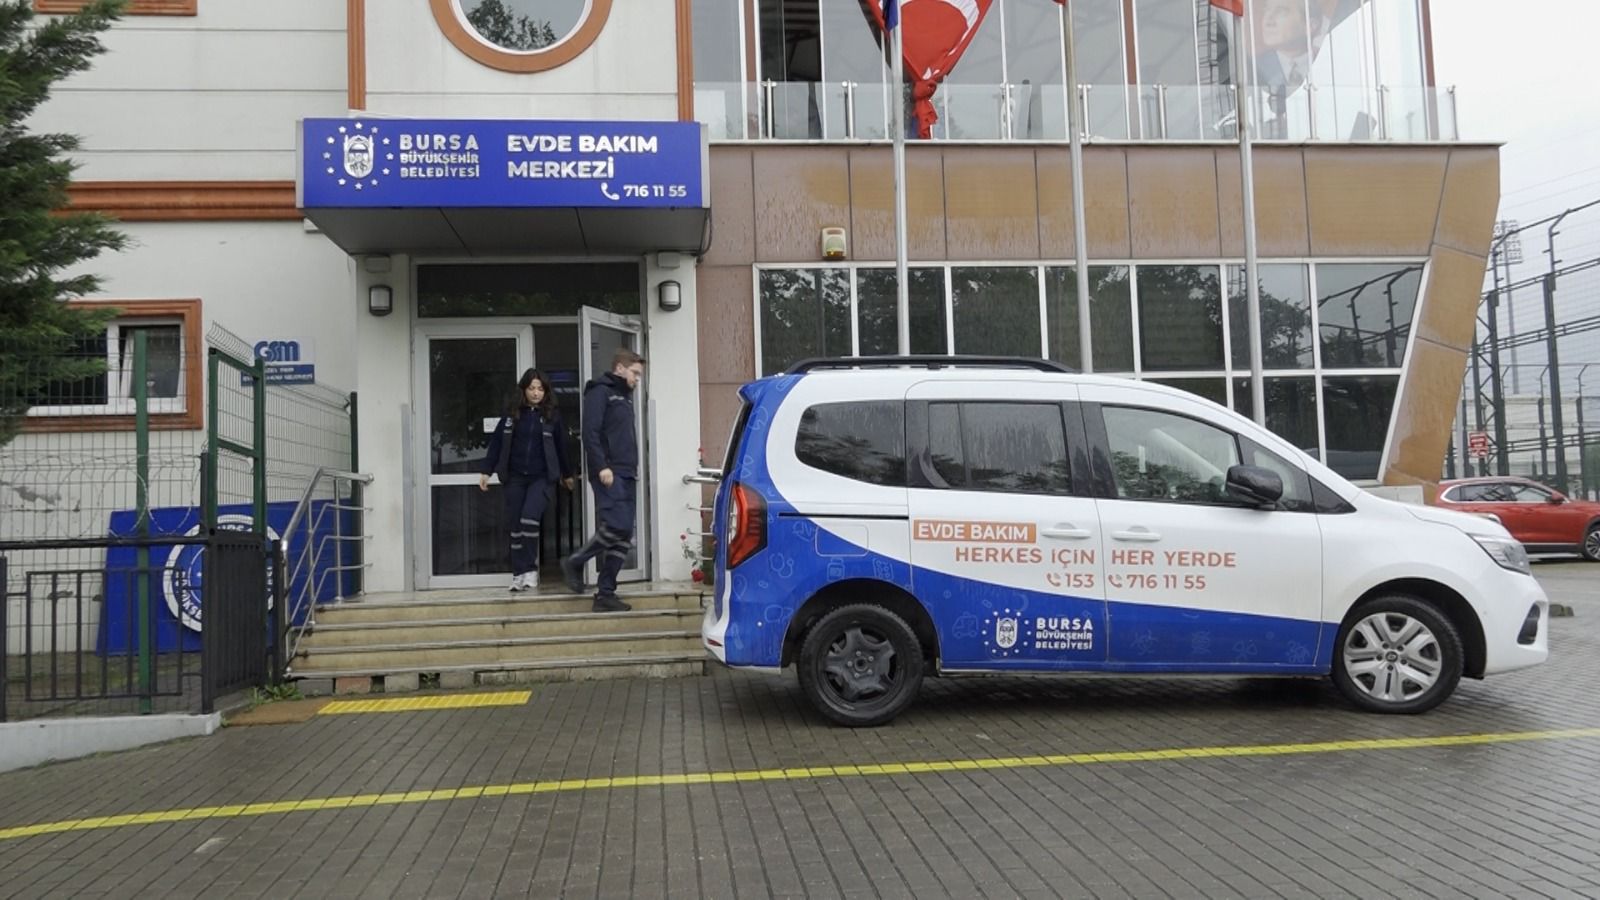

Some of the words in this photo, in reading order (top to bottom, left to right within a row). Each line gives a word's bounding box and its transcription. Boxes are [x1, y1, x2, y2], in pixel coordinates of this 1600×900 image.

[400, 134, 479, 151] BURSA
[507, 135, 572, 153] EVDE
[579, 135, 658, 153] BAKIM
[400, 152, 480, 165] BÜYÜKŞEHİR
[400, 165, 480, 178] BELEDİYESİ
[508, 156, 615, 179] MERKEZİ
[623, 184, 649, 198] 716
[652, 184, 665, 198] 11
[668, 184, 688, 198] 55
[917, 524, 966, 540] EVDE
[969, 525, 1029, 541] BAKIM
[955, 547, 1043, 564] HERKES
[1051, 547, 1096, 569] İÇİN
[1111, 549, 1155, 566] HER
[1163, 550, 1237, 568] YERDE
[1065, 573, 1095, 589] 153
[1126, 574, 1158, 590] 716
[1163, 574, 1178, 590] 11
[1183, 574, 1206, 590] 55
[1035, 617, 1094, 631] BURSA
[1035, 629, 1093, 642] BÜYÜKŞEHİR
[1035, 638, 1093, 650] BELEDİYESİ
